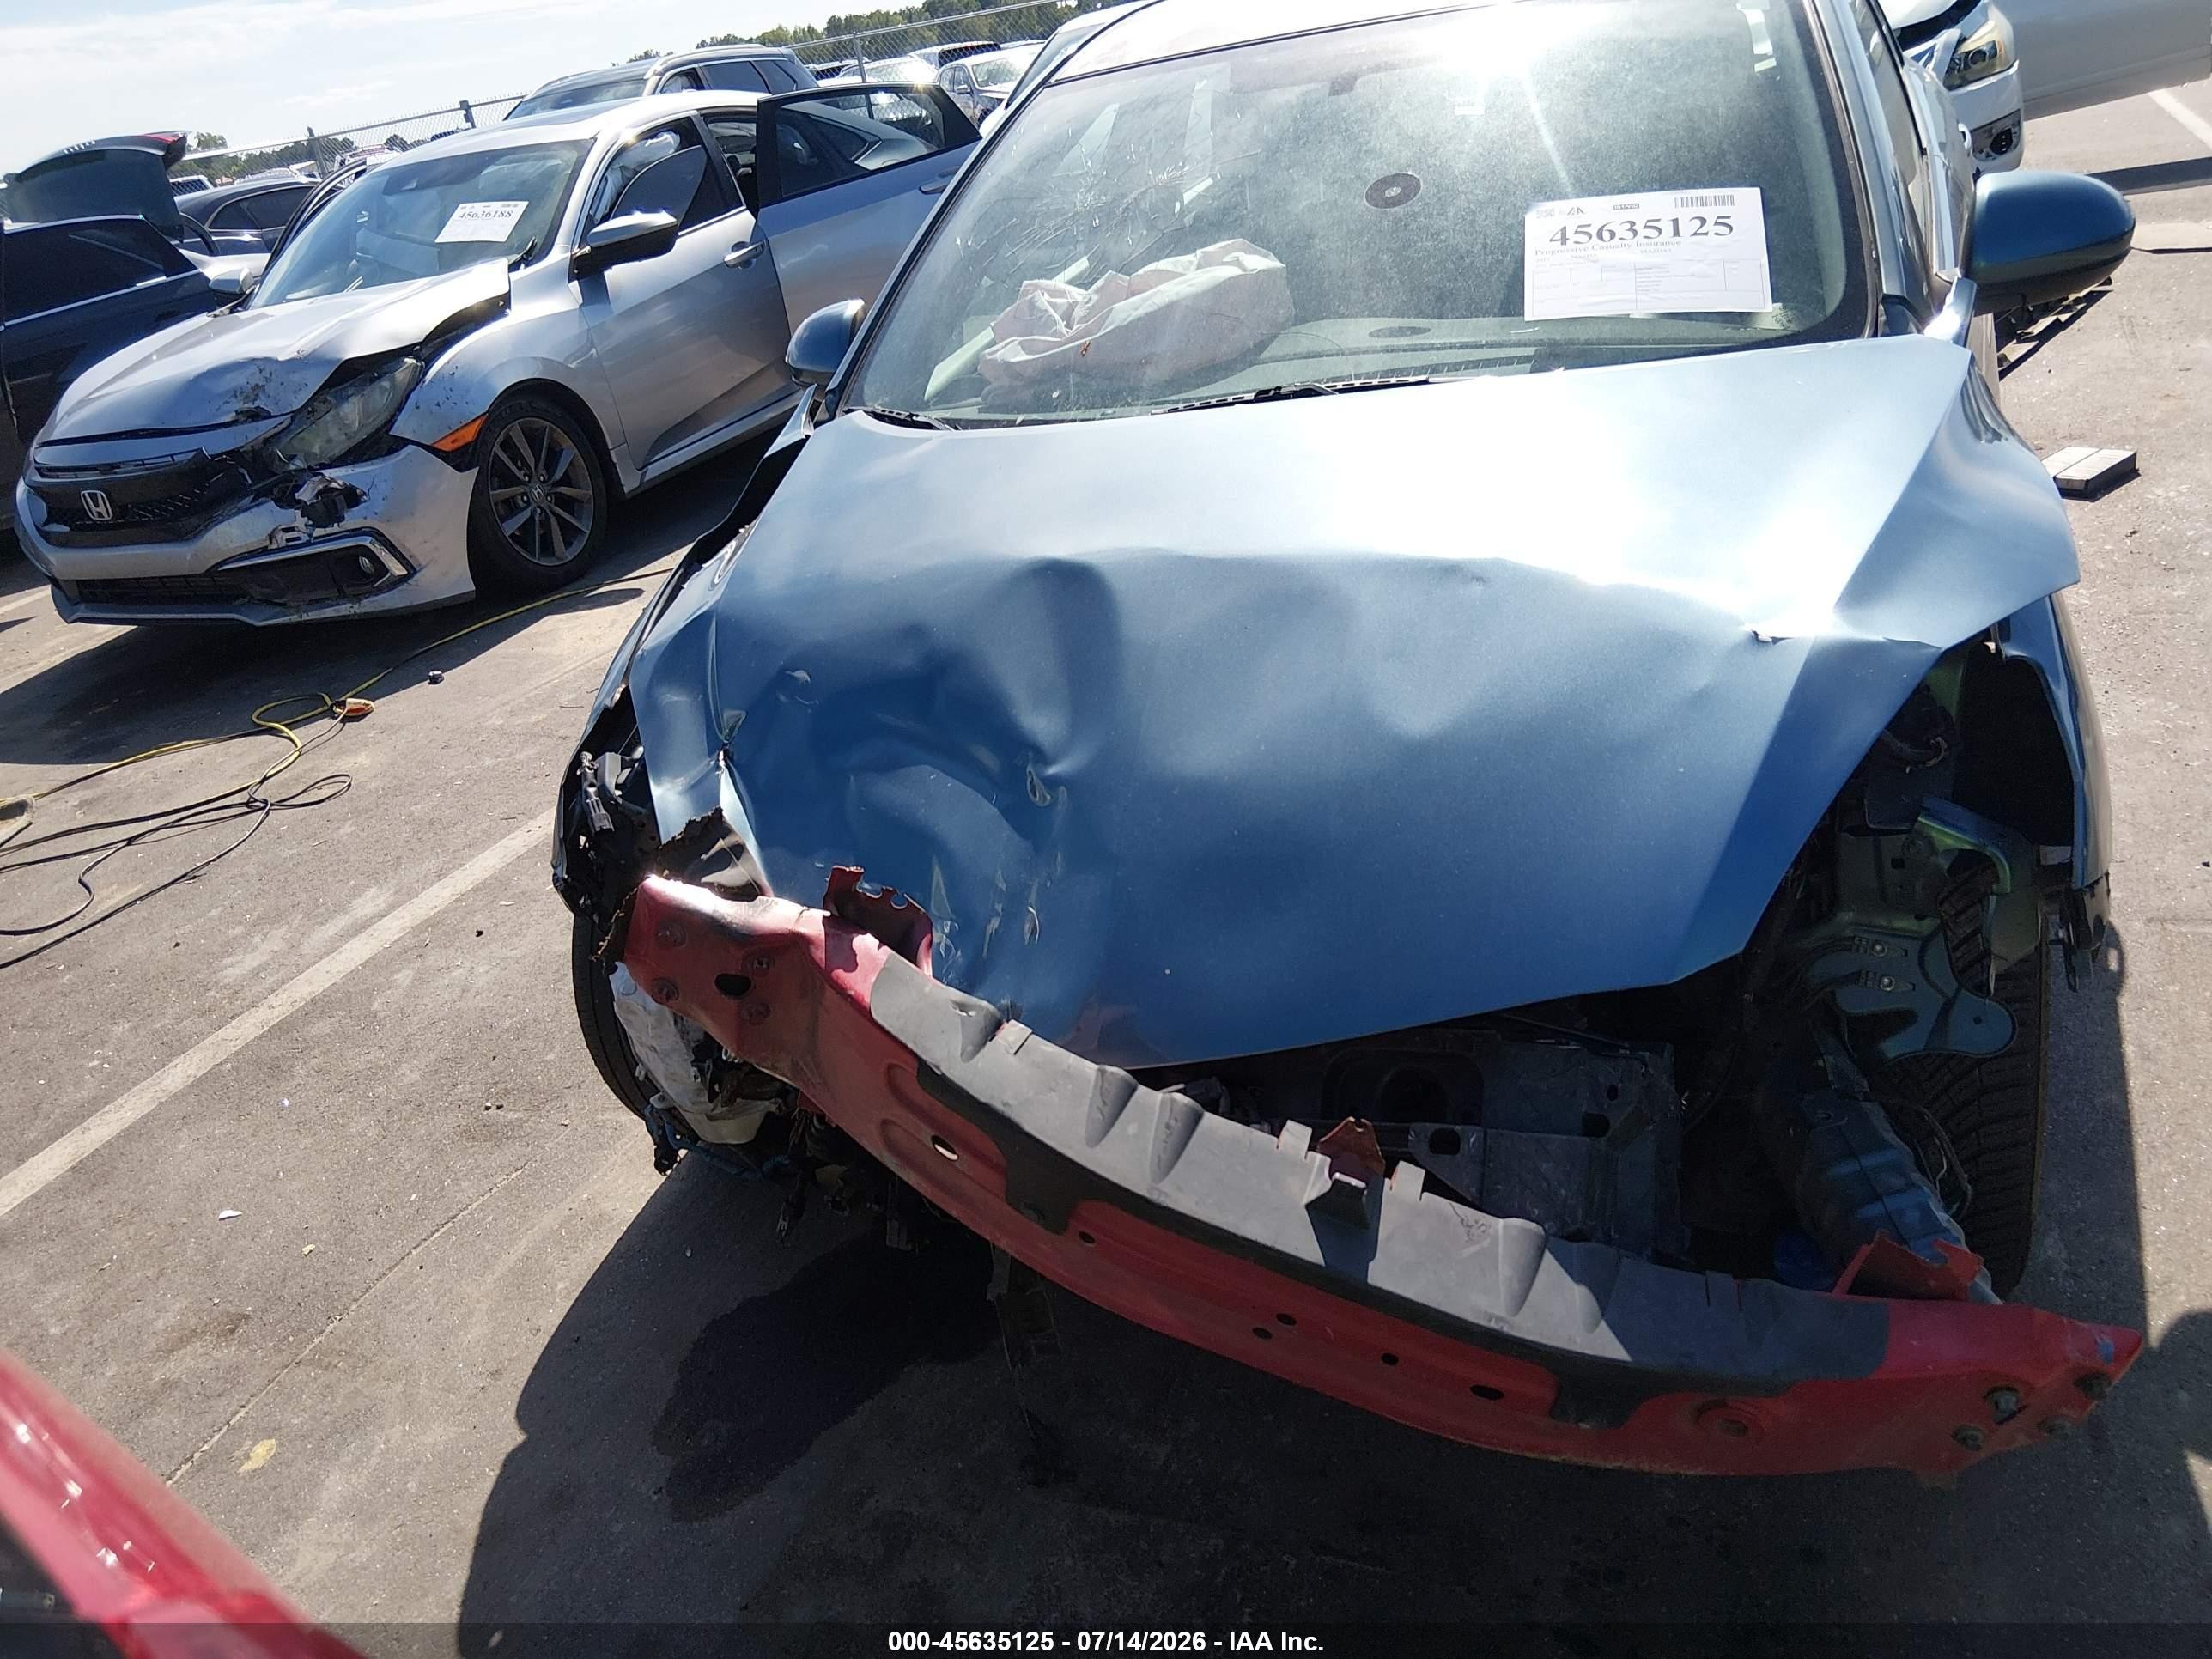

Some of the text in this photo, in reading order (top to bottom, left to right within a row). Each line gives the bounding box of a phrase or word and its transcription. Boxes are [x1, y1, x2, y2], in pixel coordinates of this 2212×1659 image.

[1549, 215, 1735, 246] 45635125
[1534, 239, 1682, 256] Progressive Casualty Insurance
